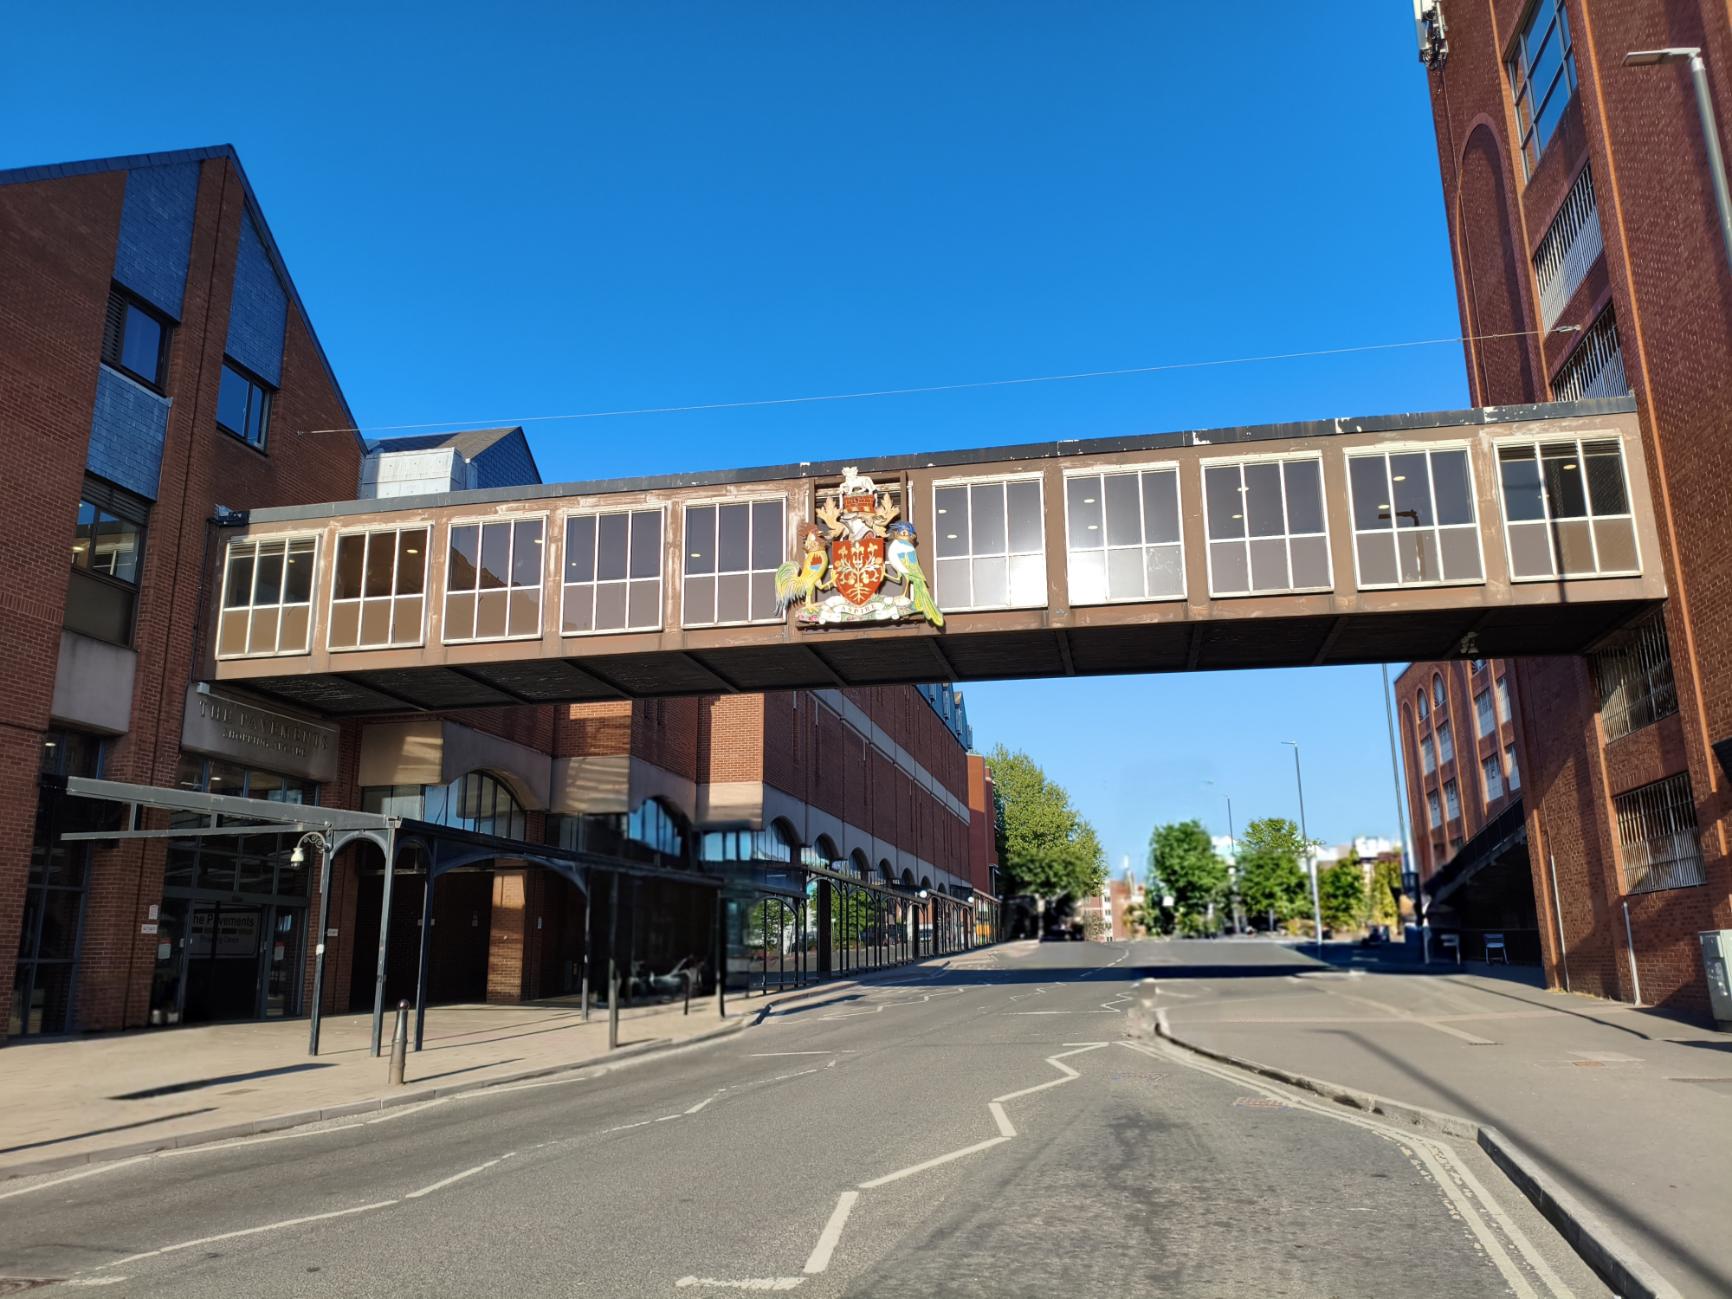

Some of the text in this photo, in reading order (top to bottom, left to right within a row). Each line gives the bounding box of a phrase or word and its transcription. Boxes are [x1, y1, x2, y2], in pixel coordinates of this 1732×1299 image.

[841, 604, 876, 613] ASPIRE
[199, 699, 328, 750] THE PAVEMENTS
[192, 912, 255, 927] he Pvements
